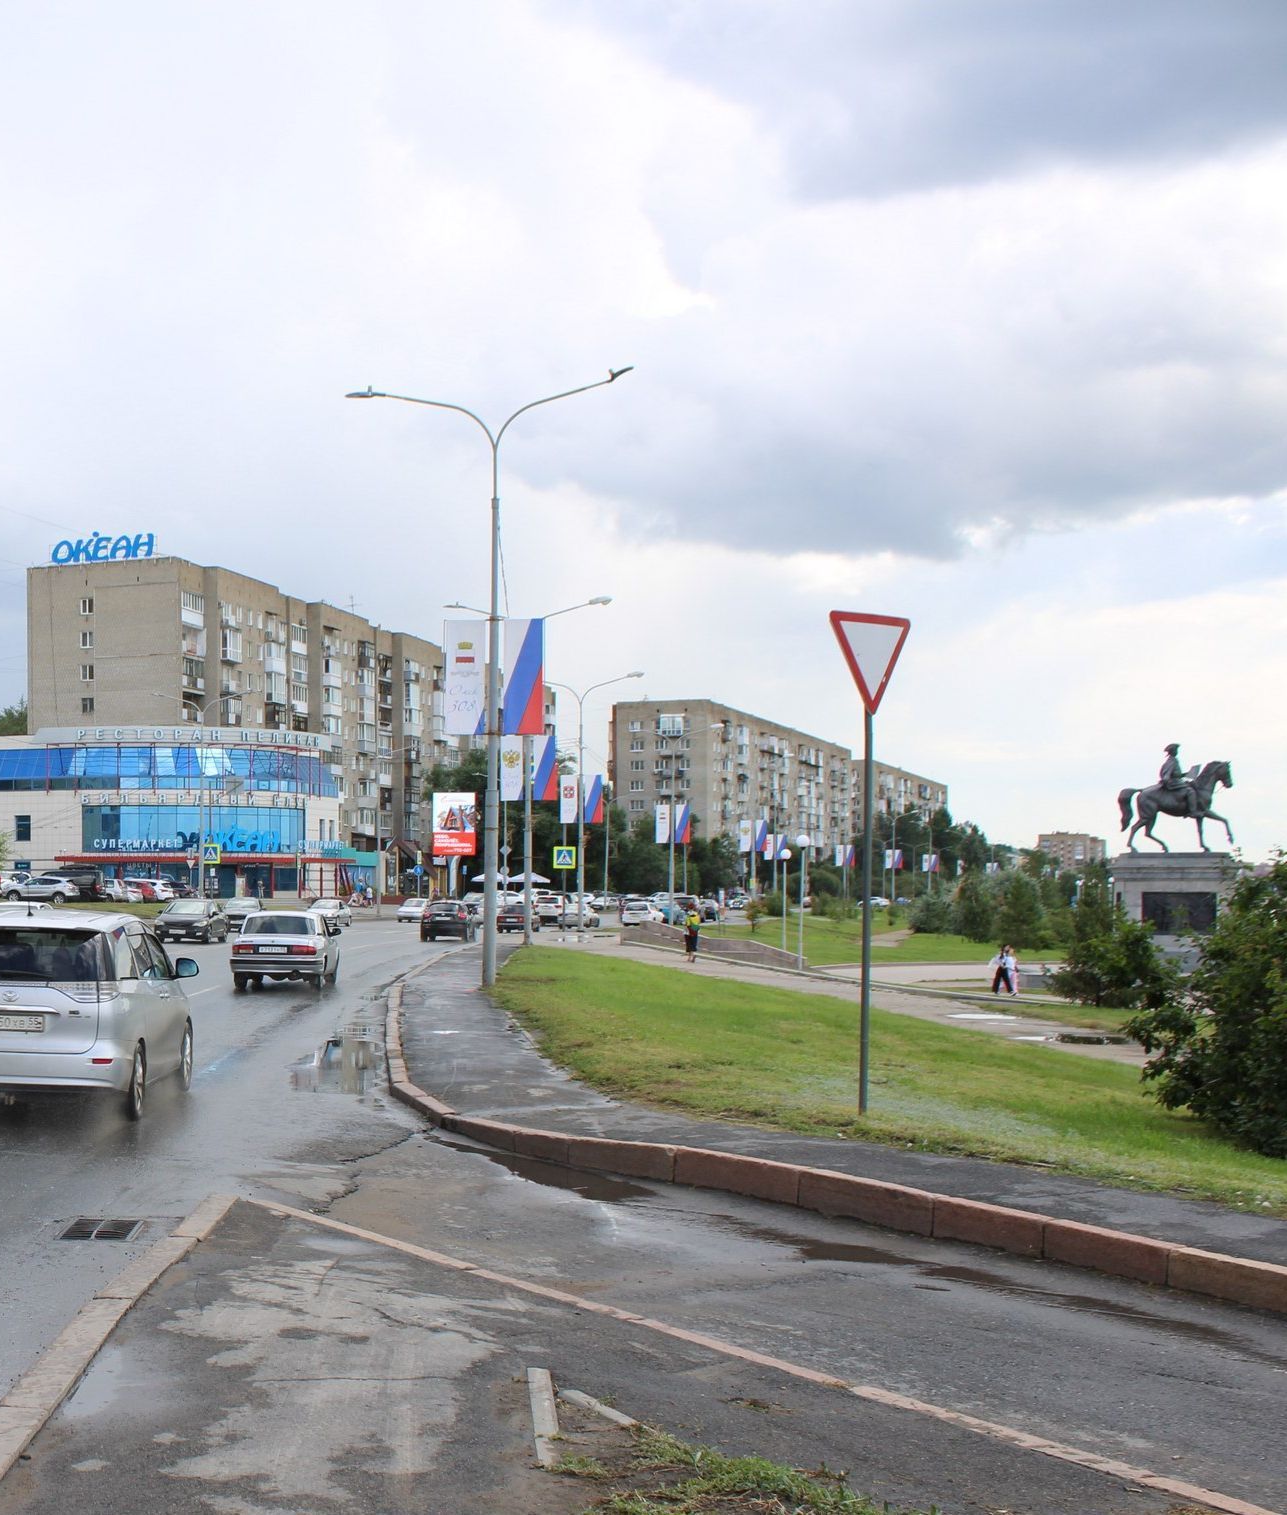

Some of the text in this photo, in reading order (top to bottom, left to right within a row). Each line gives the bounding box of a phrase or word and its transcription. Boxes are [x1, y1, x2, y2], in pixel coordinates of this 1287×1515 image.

[52, 531, 154, 564] ОКЕАН
[77, 729, 320, 746] РЕСТОРАН ПЕЛИКАН
[94, 838, 178, 849] СУПЕРМАРКЕТ
